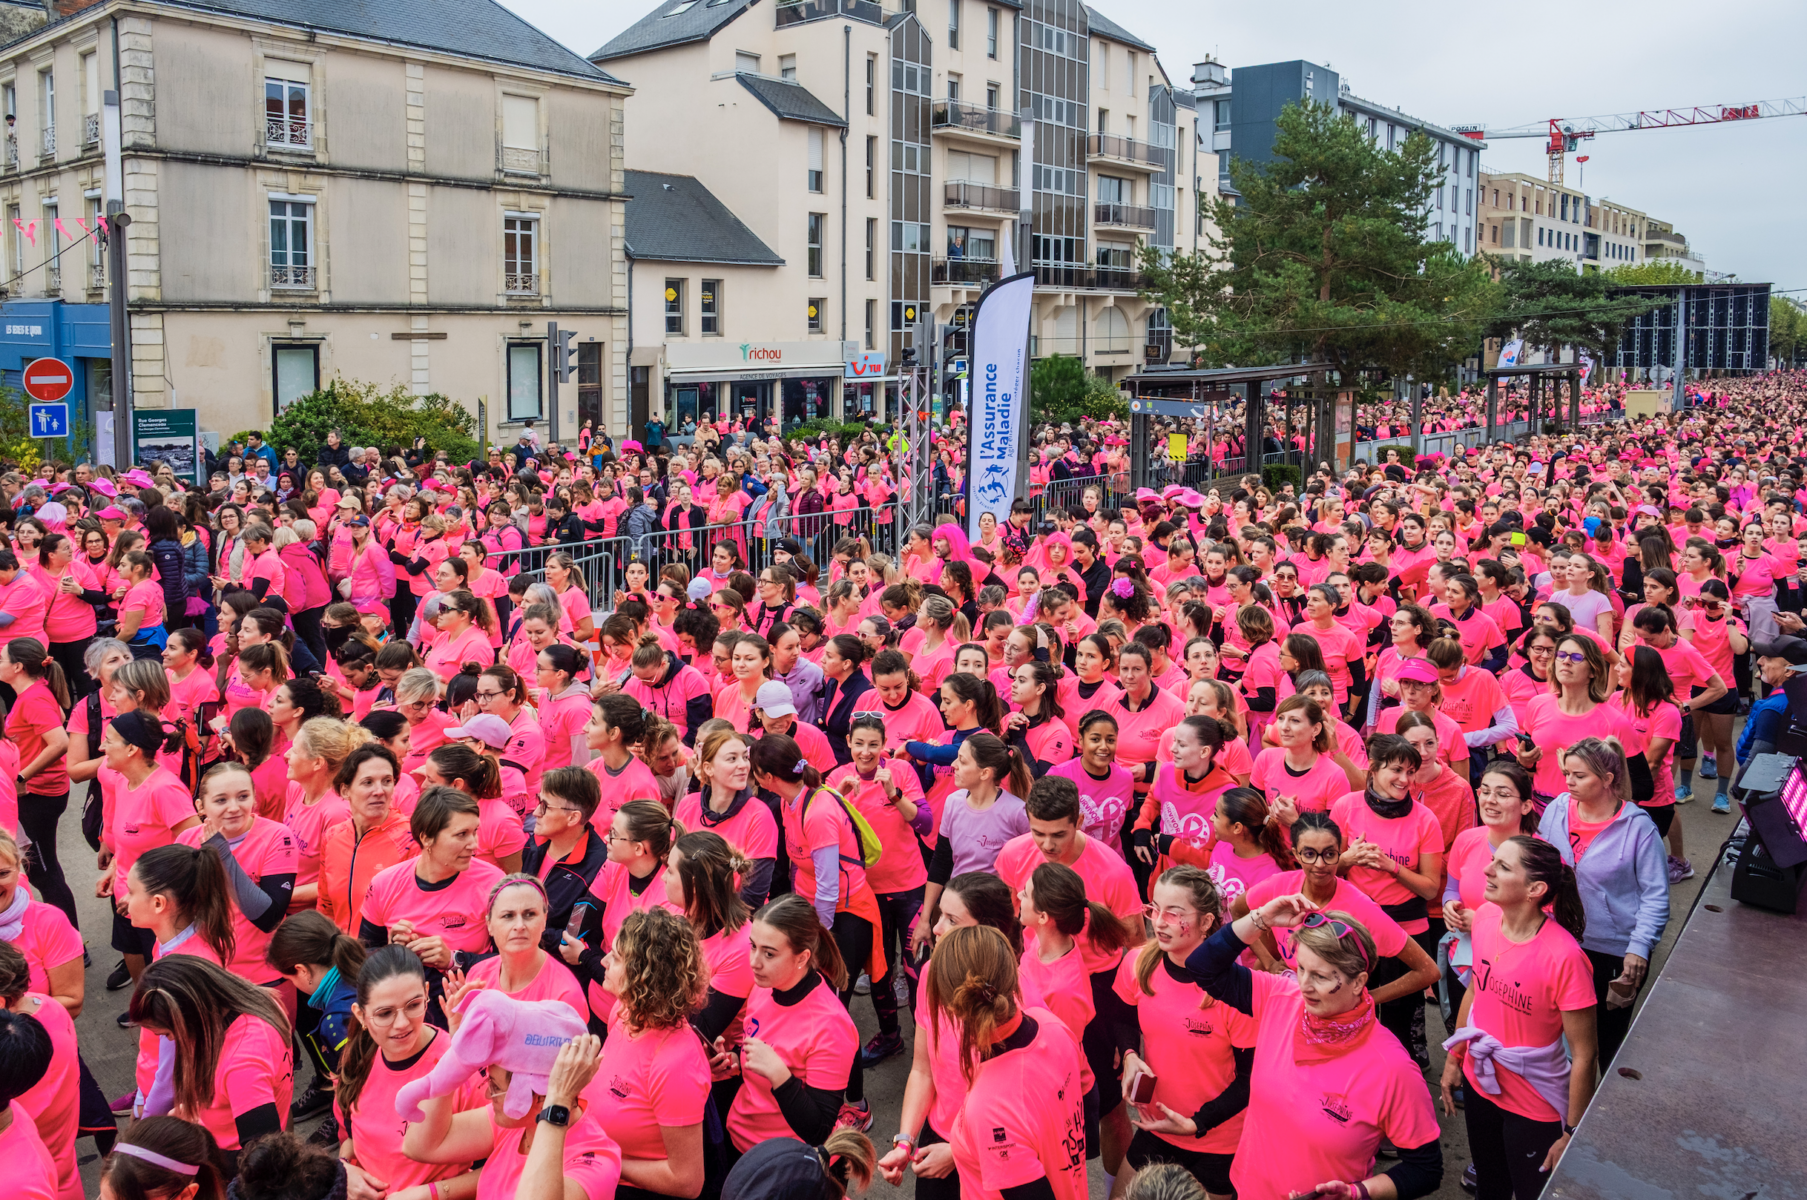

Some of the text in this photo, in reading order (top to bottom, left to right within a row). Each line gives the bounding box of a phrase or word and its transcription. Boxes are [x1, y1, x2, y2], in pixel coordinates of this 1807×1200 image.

[749, 347, 782, 360] richou
[869, 364, 881, 372] TUI
[980, 363, 997, 460] l'Assurance
[996, 393, 1012, 460] Maladie
[1079, 796, 1100, 823] URVIVOR
